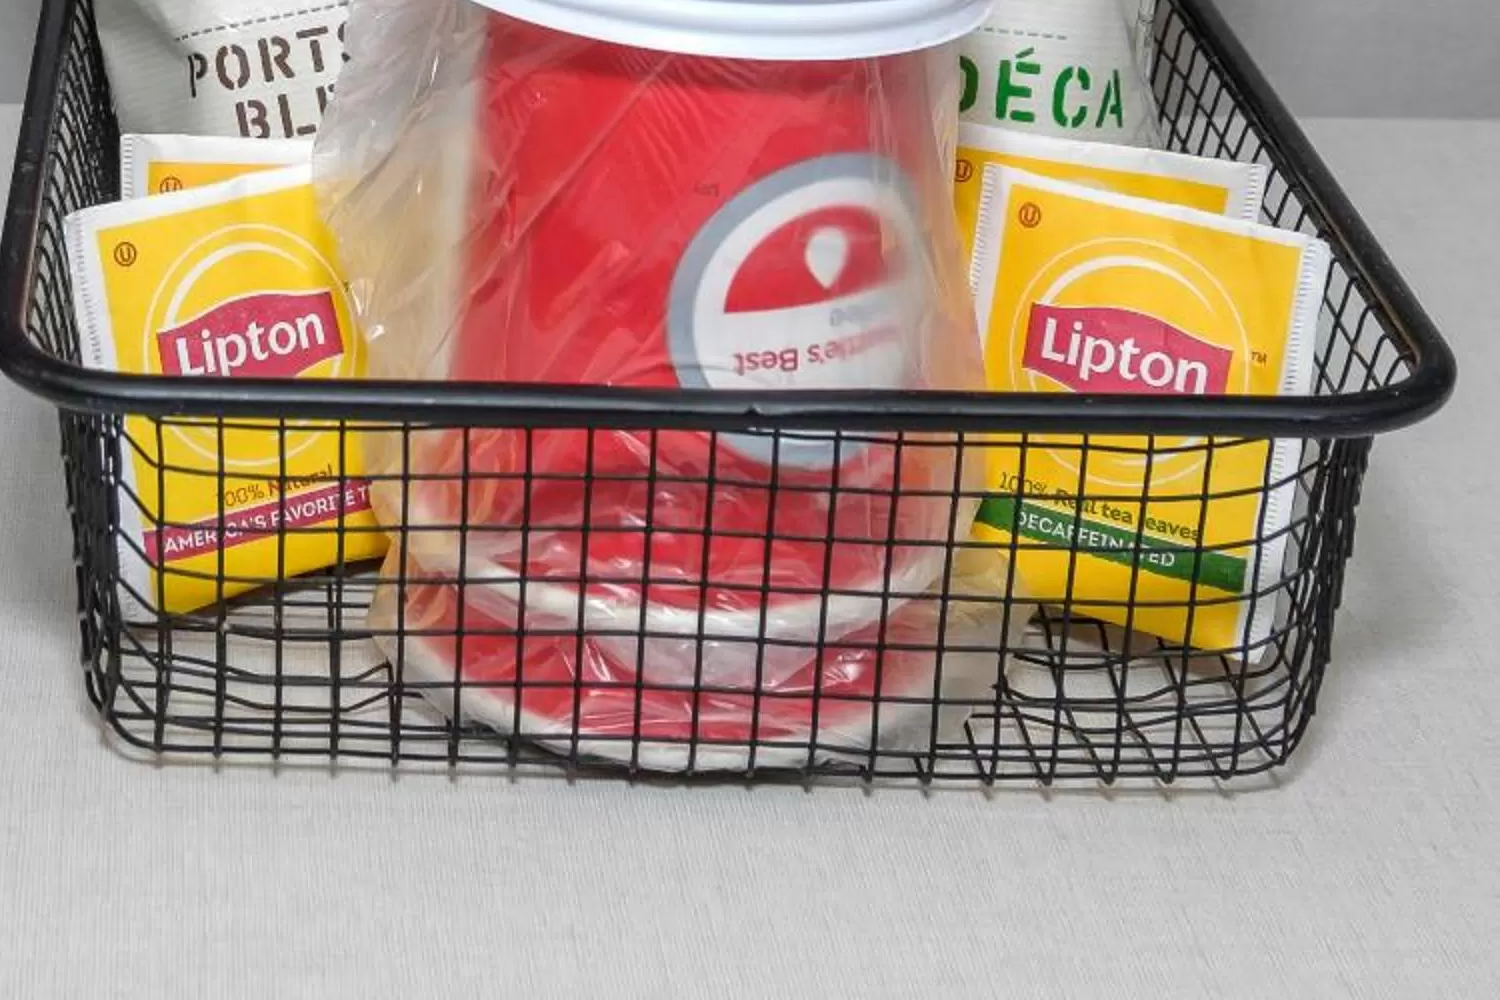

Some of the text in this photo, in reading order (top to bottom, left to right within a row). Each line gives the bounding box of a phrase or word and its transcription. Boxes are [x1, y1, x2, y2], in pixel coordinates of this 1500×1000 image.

[176, 312, 325, 376] Lipton
[733, 348, 798, 376] Best
[1041, 317, 1208, 394] Lipton
[164, 515, 267, 553] AMERCA'S
[1101, 499, 1133, 525] tea
[1143, 514, 1201, 541] eaves
